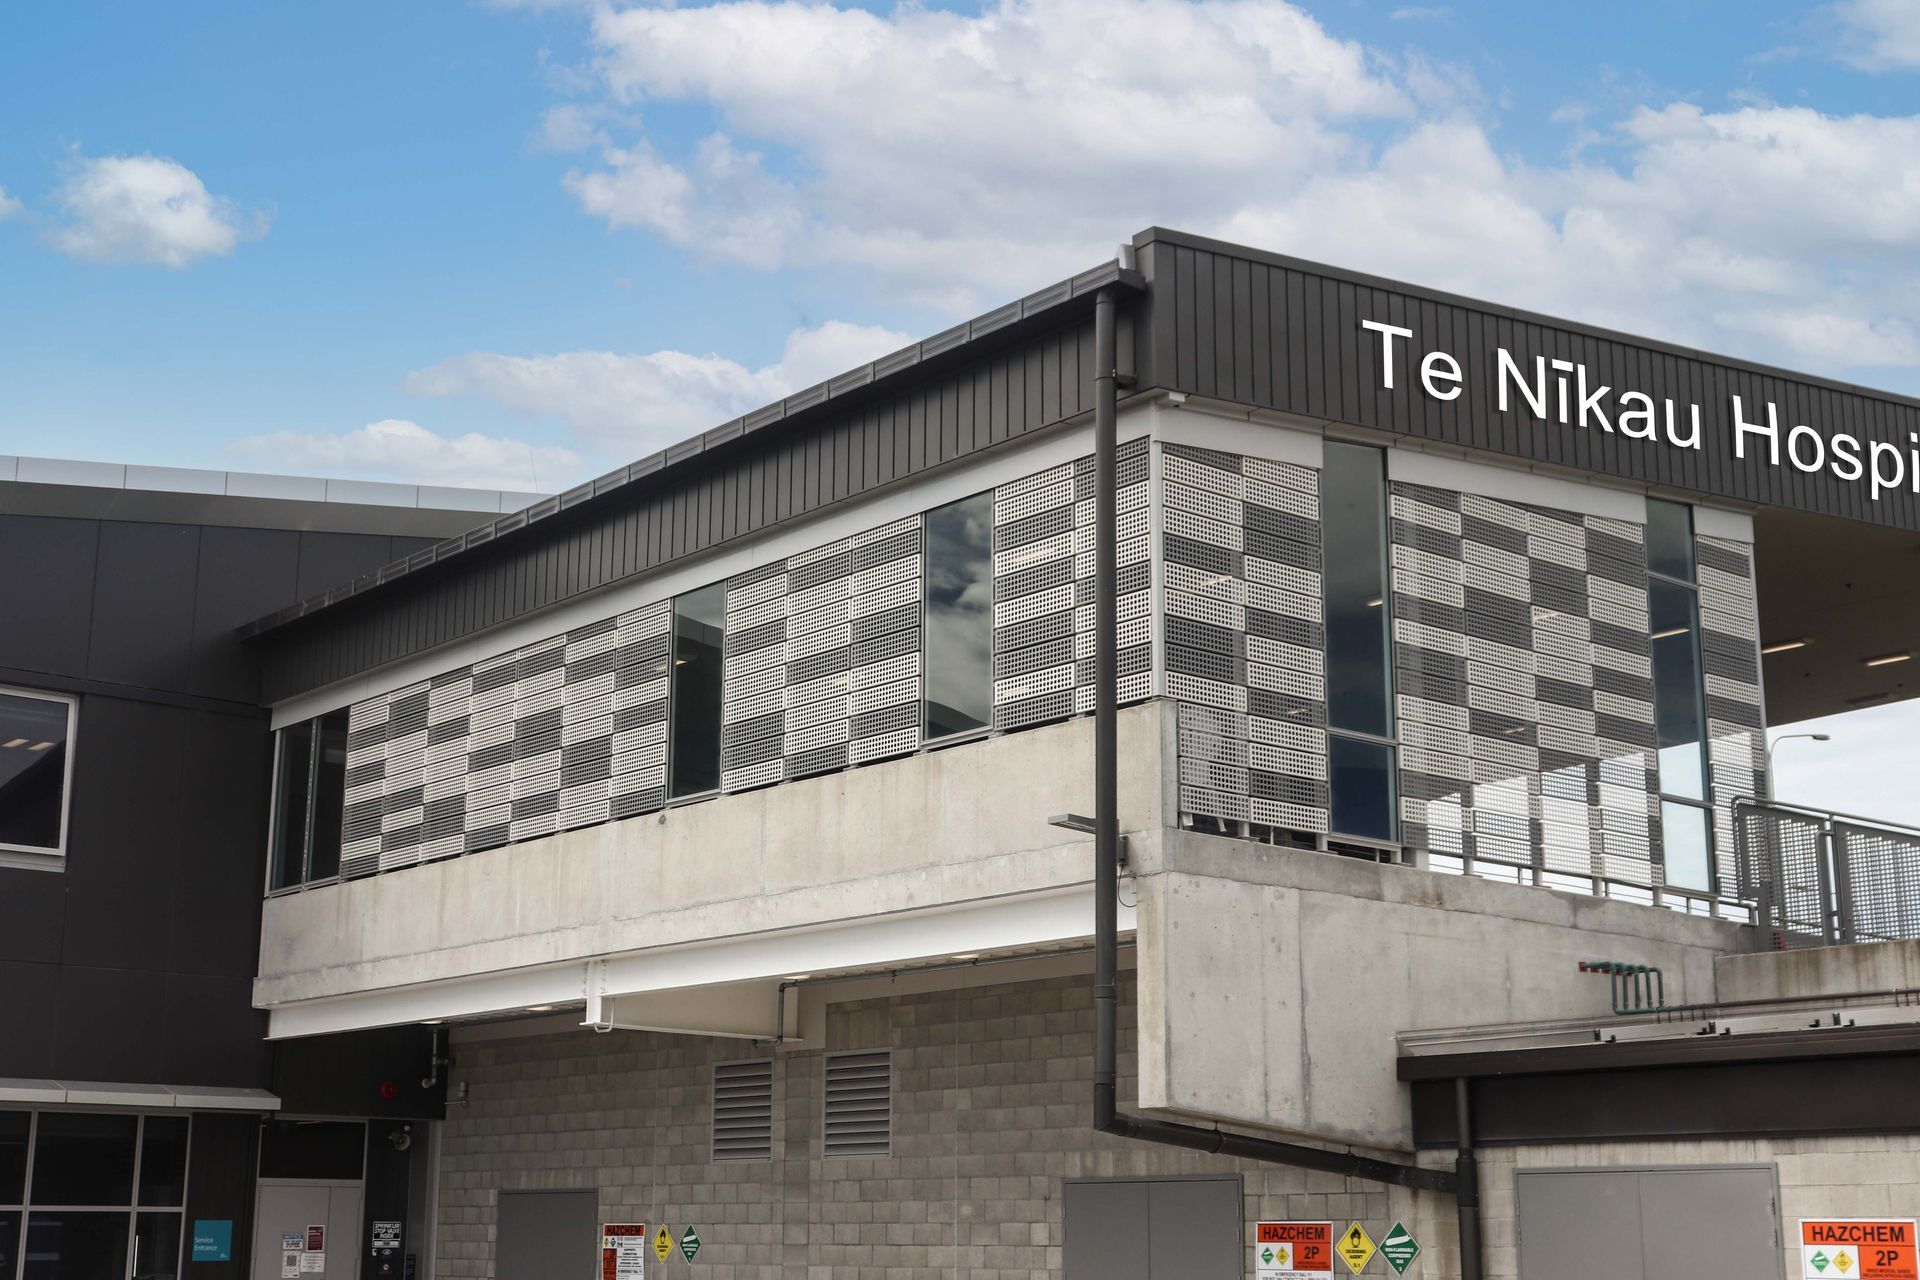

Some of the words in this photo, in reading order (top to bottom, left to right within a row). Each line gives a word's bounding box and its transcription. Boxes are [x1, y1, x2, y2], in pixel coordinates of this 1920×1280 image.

[1363, 320, 1463, 400] Te
[1498, 348, 1701, 449] Nīkau
[1733, 396, 1920, 500] Hospi
[606, 1225, 641, 1236] HAZCHEM
[1263, 1226, 1325, 1240] HAZCHEM
[1812, 1226, 1905, 1242] HAZCHEM
[194, 1236, 214, 1244] Service
[1304, 1246, 1320, 1260] 2P
[1876, 1250, 1898, 1266] 2P
